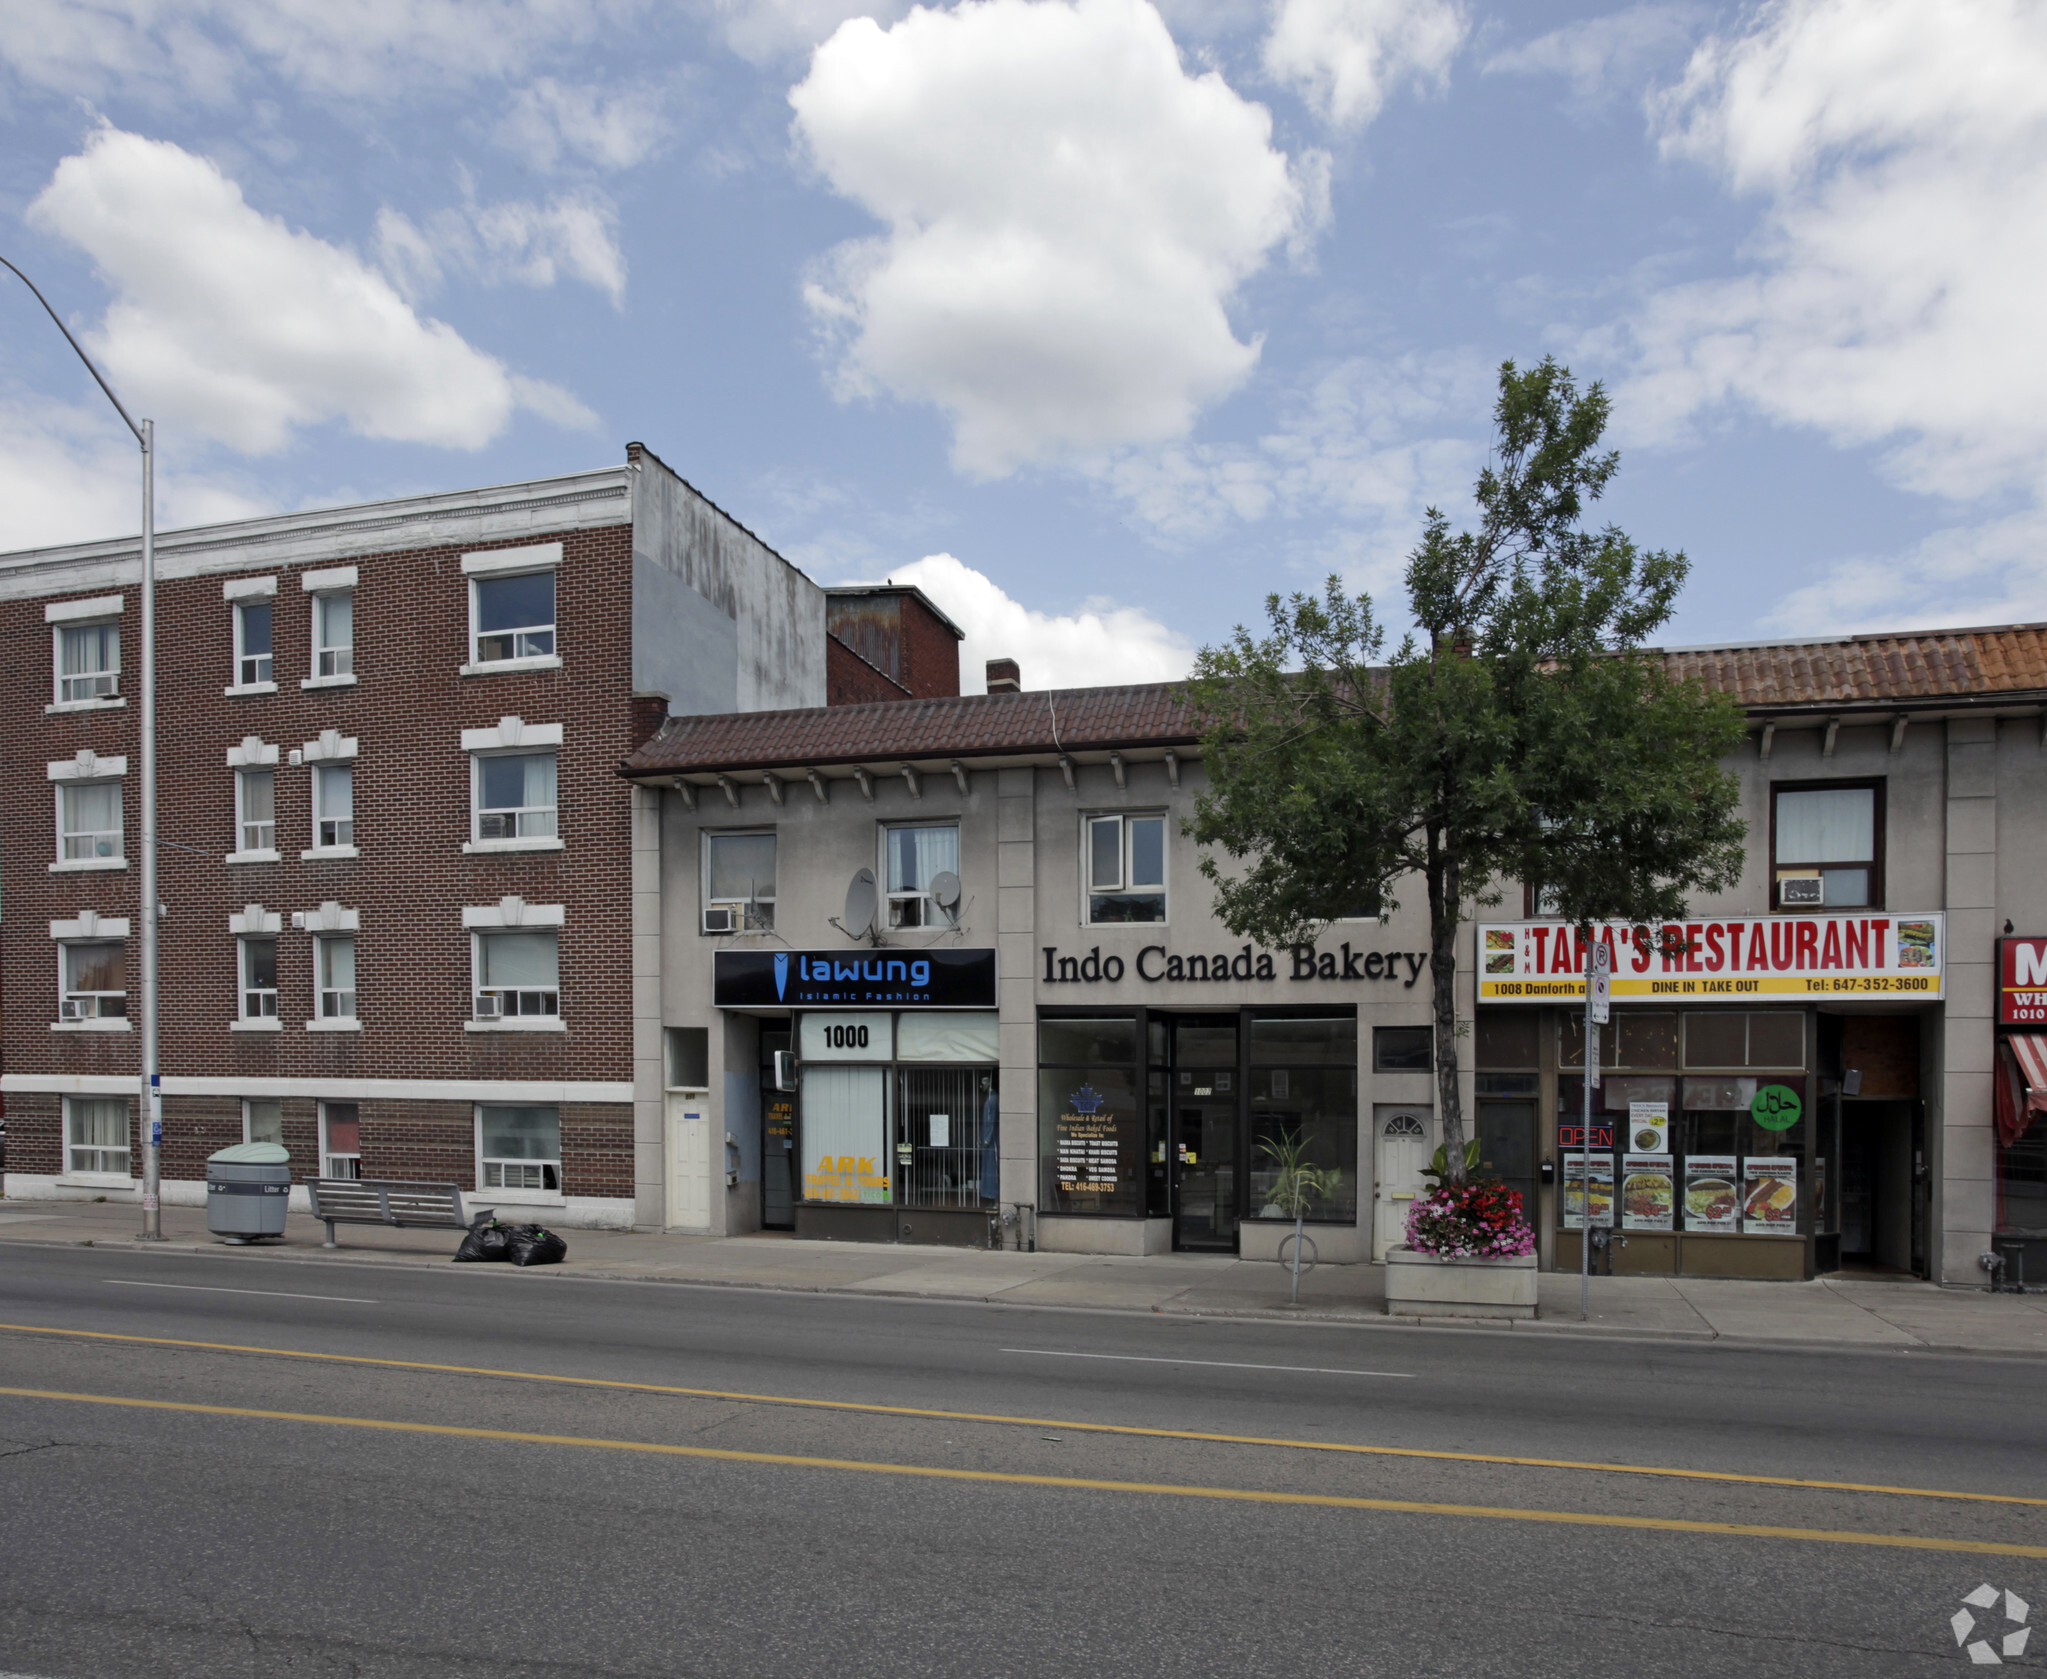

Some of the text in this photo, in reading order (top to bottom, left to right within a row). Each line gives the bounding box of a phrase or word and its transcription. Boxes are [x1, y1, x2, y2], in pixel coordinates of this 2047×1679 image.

[1661, 919, 1890, 973] RESTAURANT
[800, 955, 930, 987] lawung
[1042, 942, 1427, 989] Indo Canada Bakery
[1494, 983, 1522, 995] 1008
[1525, 982, 1575, 994] Danforth
[1651, 980, 1759, 993] DINE IN TAKE OUT
[1806, 978, 1928, 991] Tel: 647-352-3600
[800, 992, 930, 1000] Islamic Fashion
[2013, 1008, 2045, 1020] 1010
[824, 1025, 869, 1048] 1000
[1756, 1091, 1798, 1114] حلال
[1559, 1127, 1613, 1146] OPEN
[817, 1155, 878, 1174] ARK
[804, 1173, 842, 1186] TRAVEL
[857, 1175, 891, 1188] TOURS
[1061, 1181, 1074, 1191] TEL:
[264, 1184, 280, 1193] Litter
